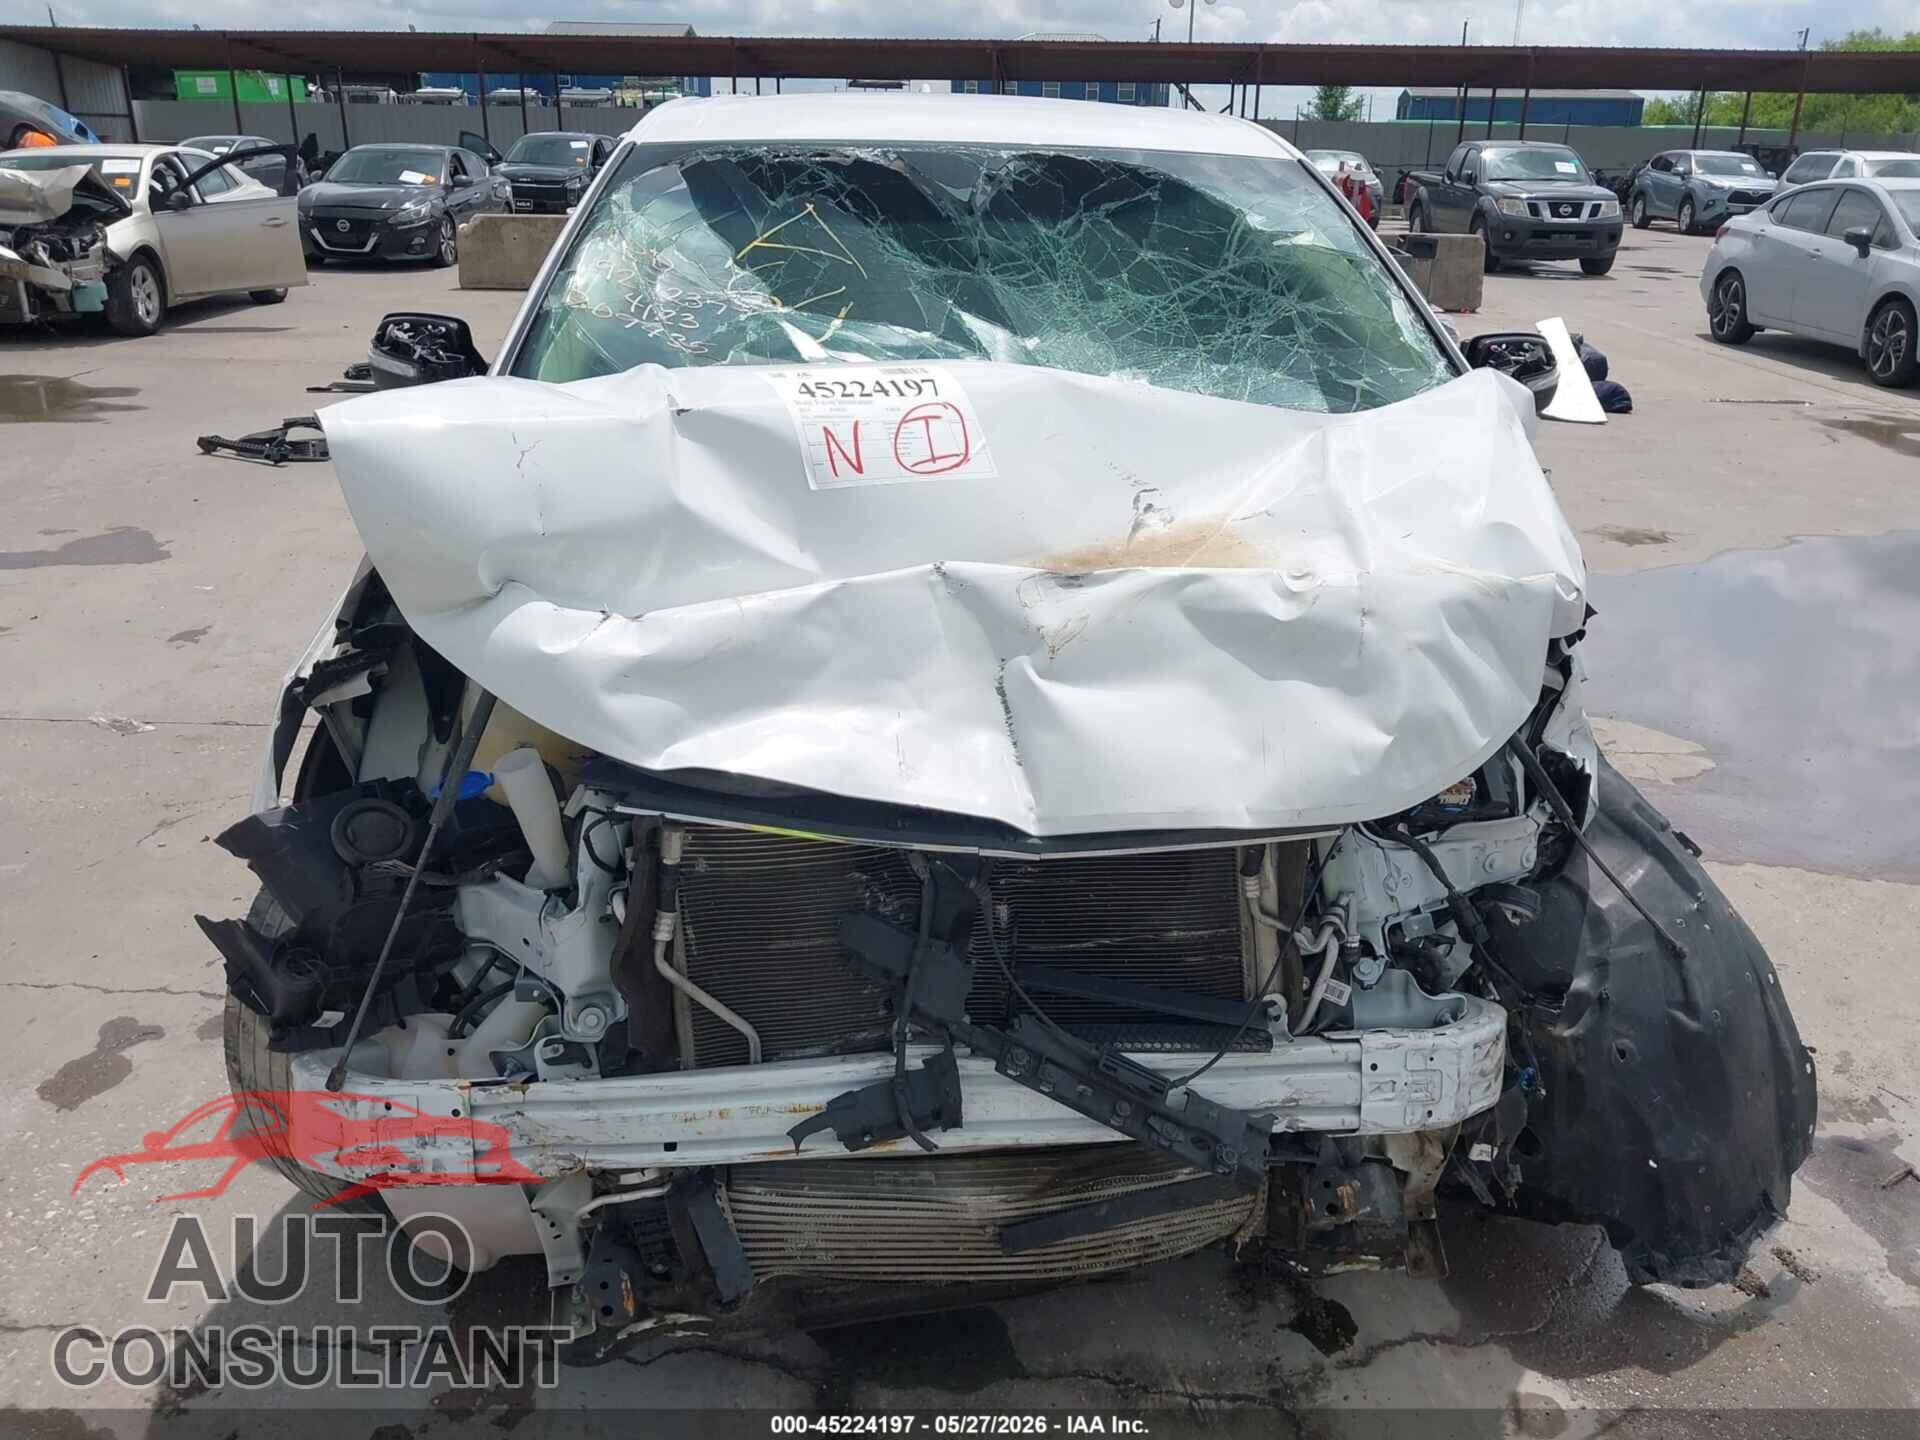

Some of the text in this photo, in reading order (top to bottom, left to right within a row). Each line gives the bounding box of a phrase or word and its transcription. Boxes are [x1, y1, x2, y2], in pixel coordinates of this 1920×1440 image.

[797, 378, 938, 398] 45224197
[822, 420, 864, 477] N
[902, 414, 961, 468] I
